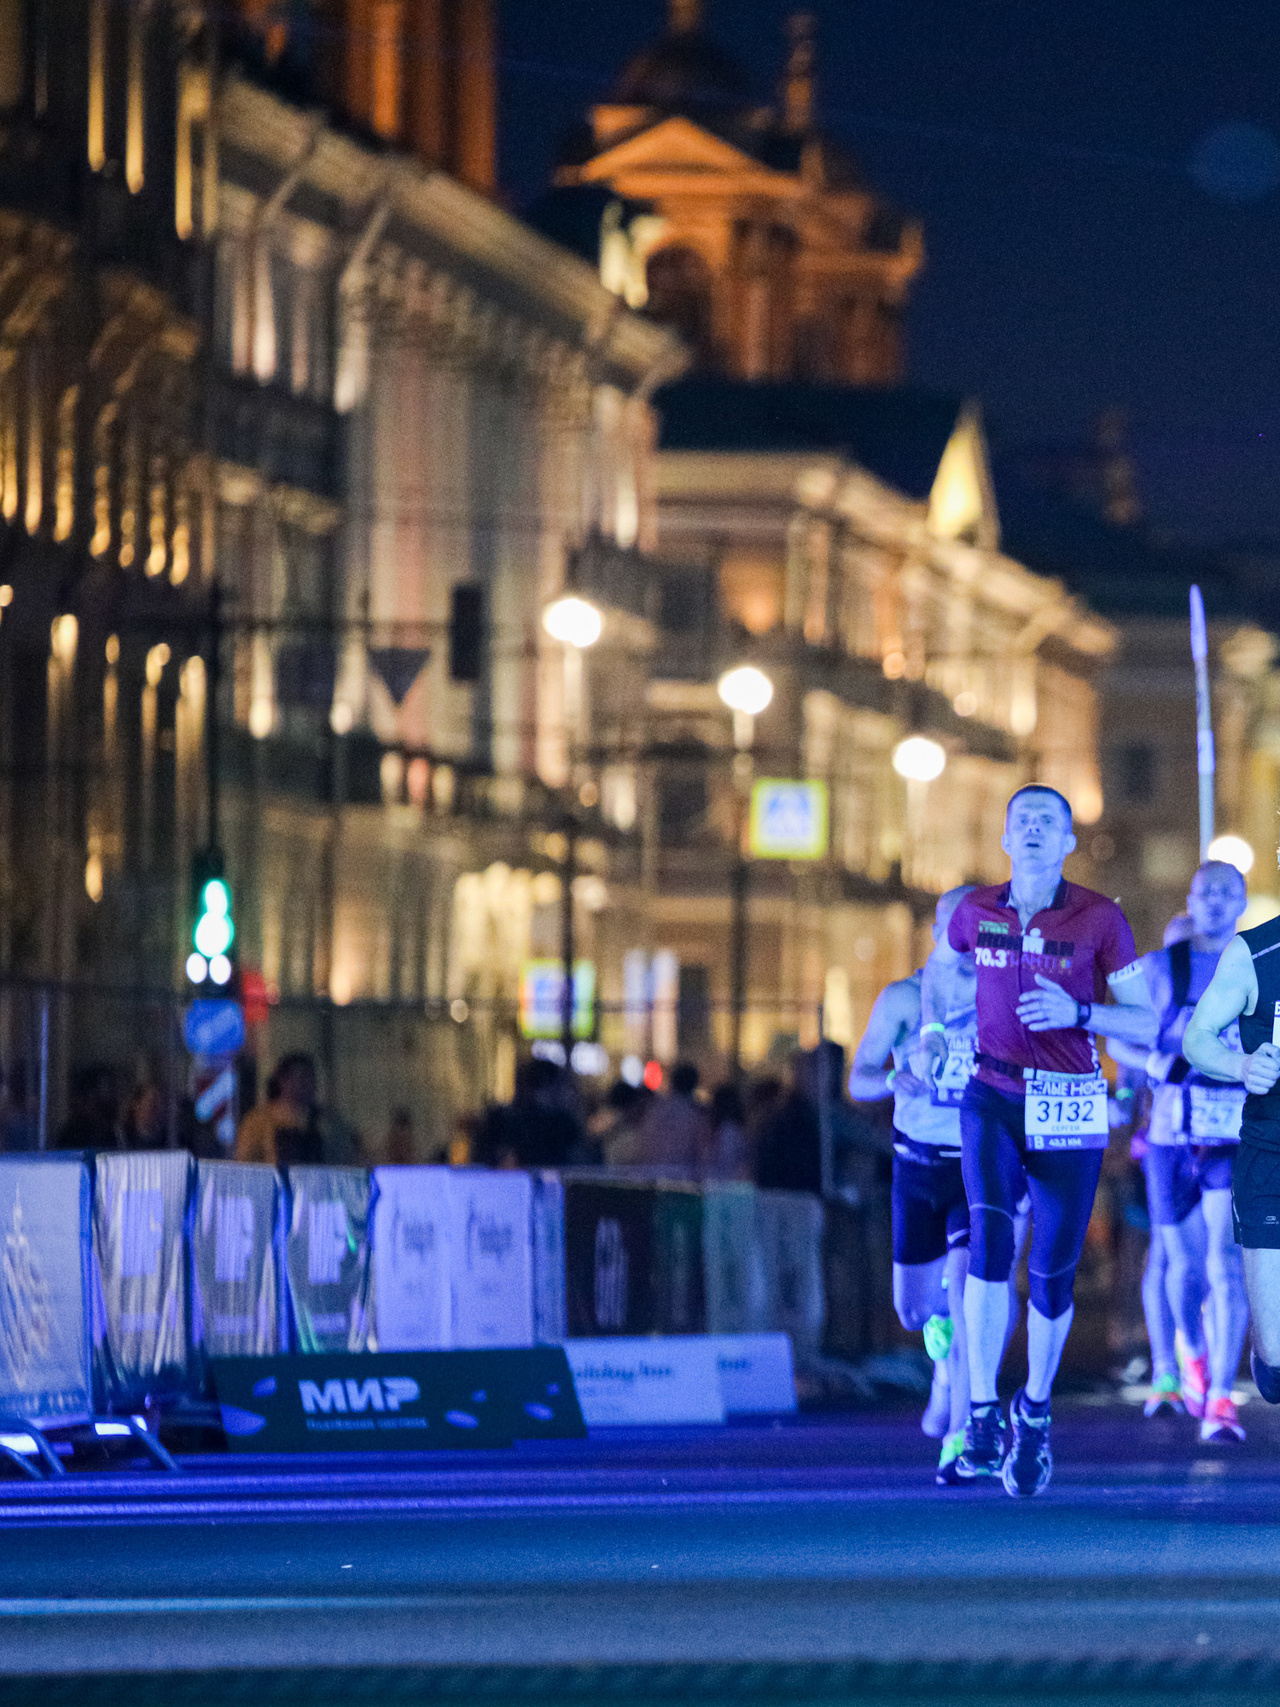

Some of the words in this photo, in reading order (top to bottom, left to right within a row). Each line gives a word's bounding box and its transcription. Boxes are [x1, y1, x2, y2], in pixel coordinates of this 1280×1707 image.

[974, 947, 1007, 969] 70.3
[1037, 1100, 1094, 1123] 3132
[298, 1376, 421, 1414] МИР
